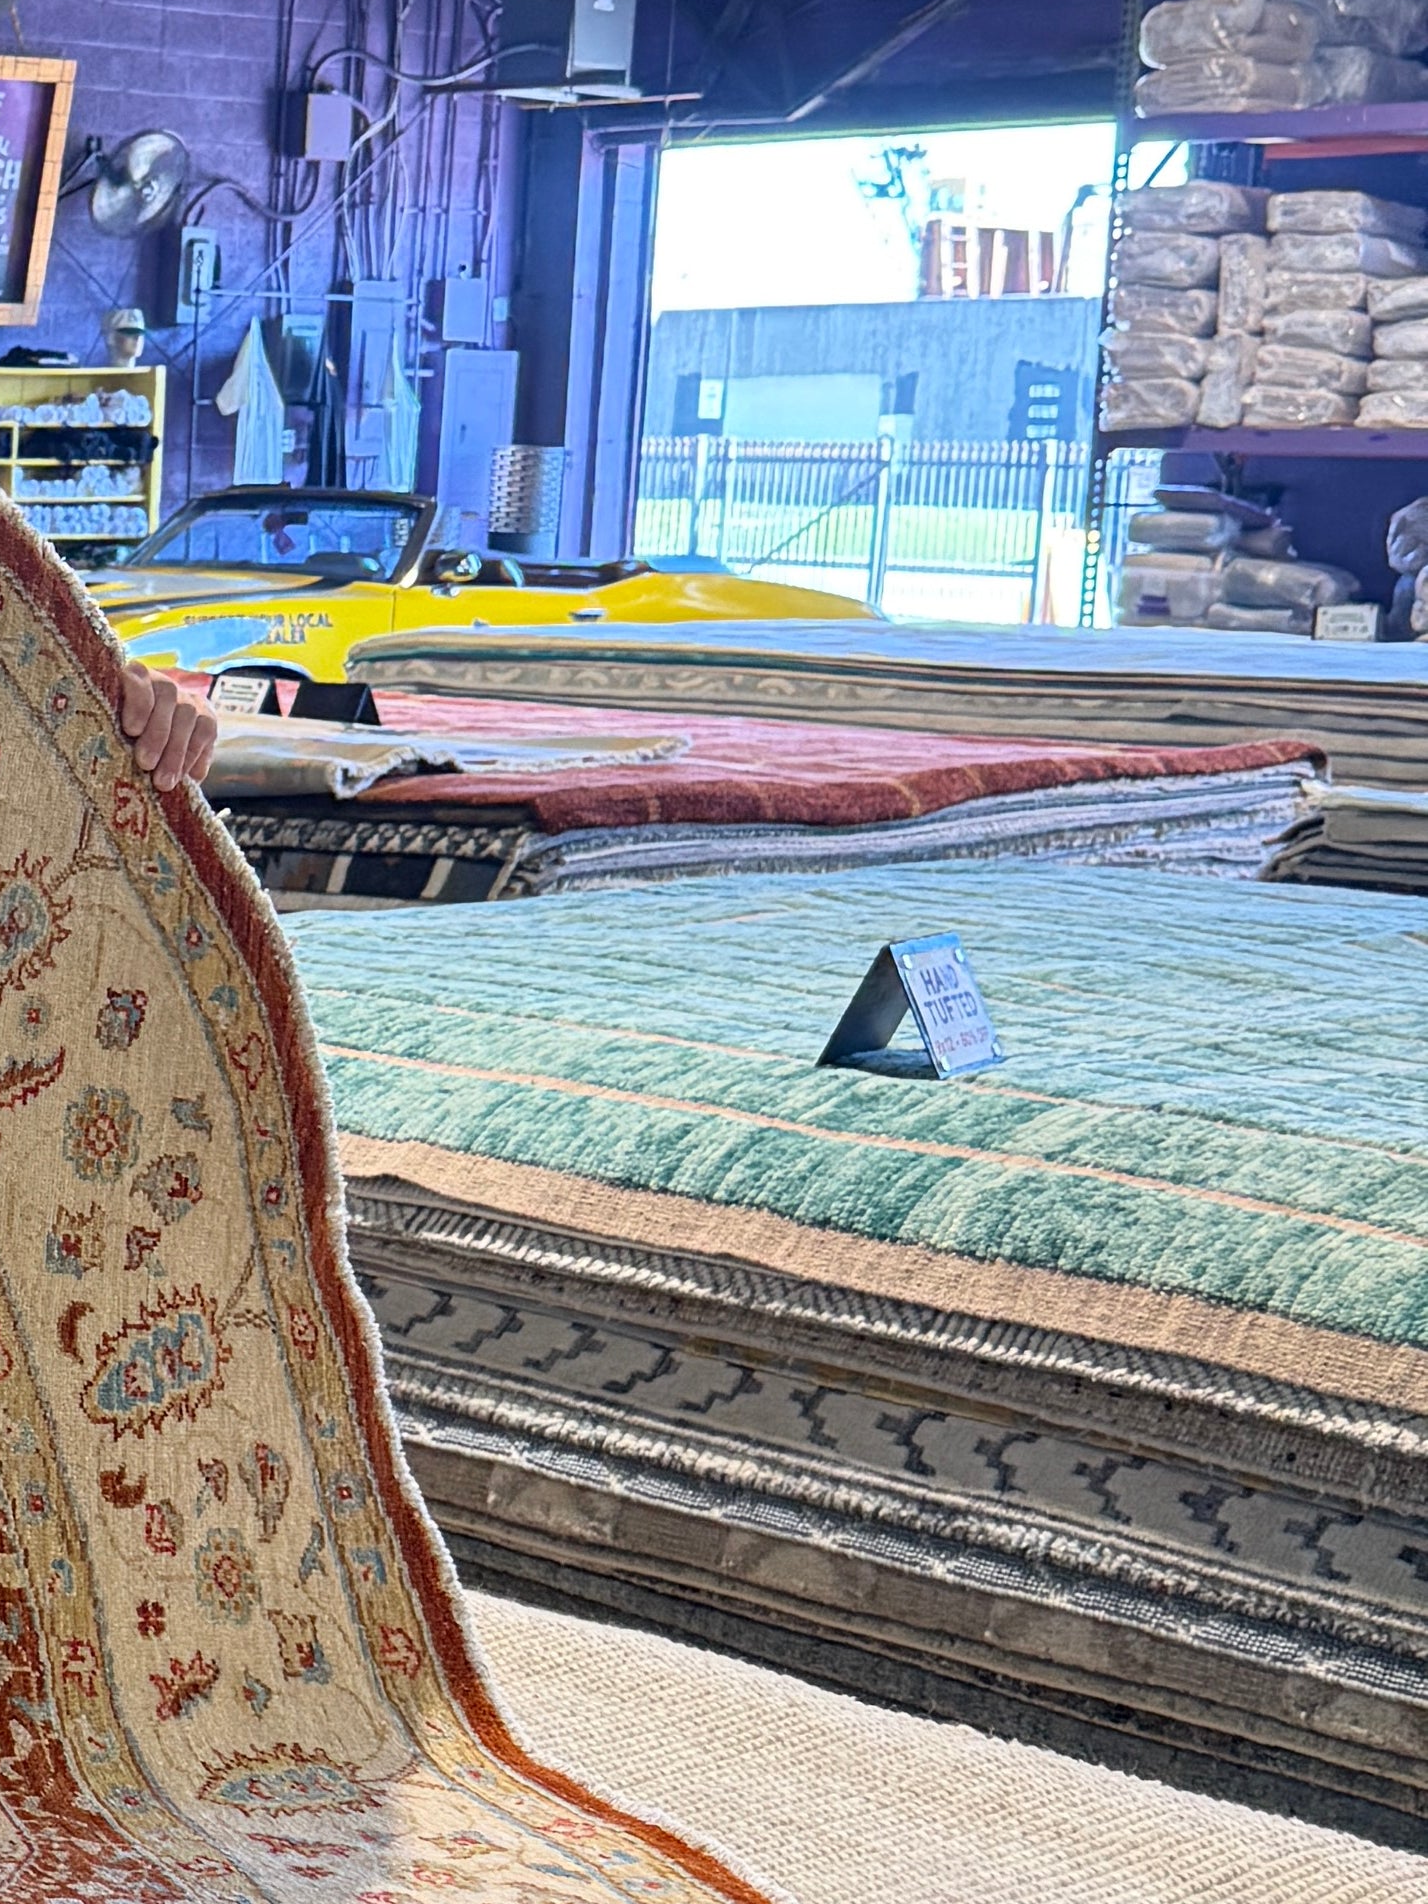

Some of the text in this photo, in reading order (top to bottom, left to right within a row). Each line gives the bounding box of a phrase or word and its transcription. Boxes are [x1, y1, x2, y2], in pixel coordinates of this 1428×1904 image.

[289, 613, 334, 628] LOCAL
[919, 964, 959, 996] HAND
[924, 991, 978, 1027] TUFTED
